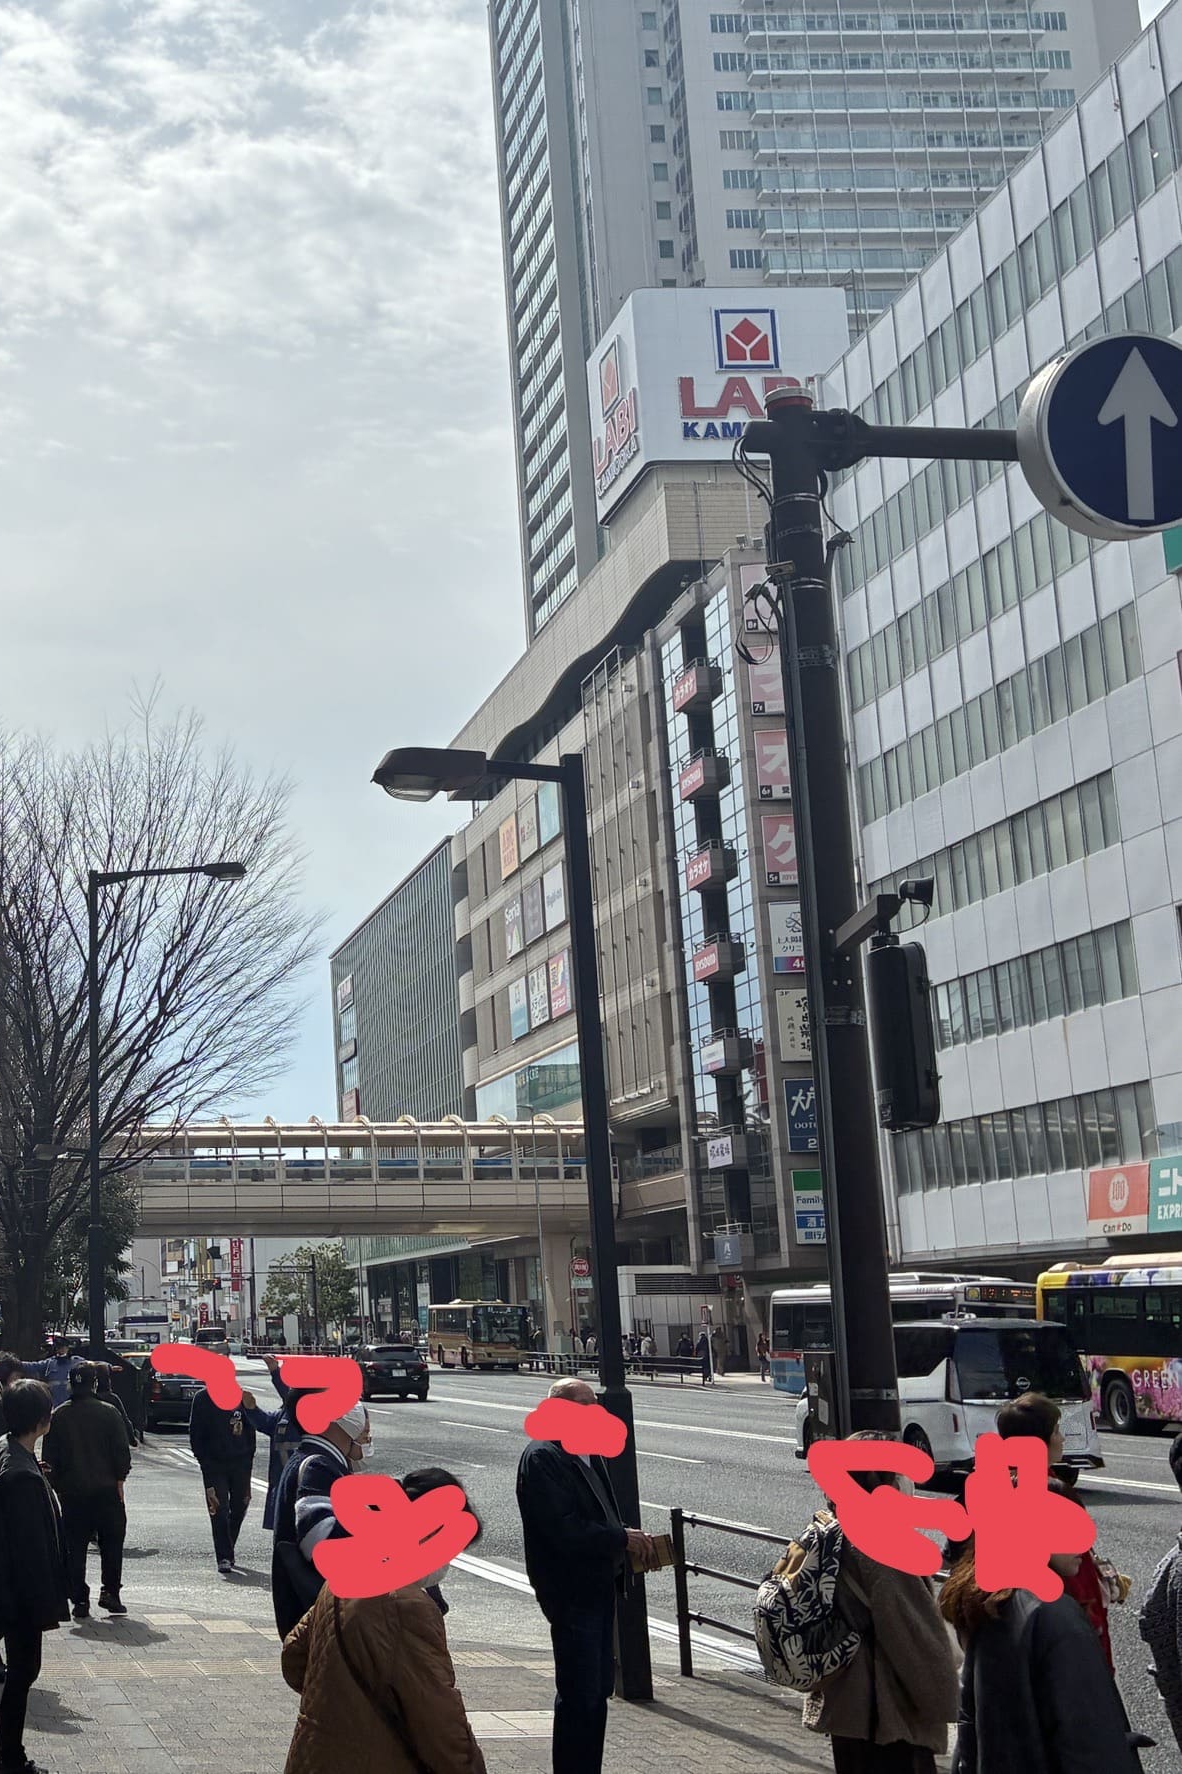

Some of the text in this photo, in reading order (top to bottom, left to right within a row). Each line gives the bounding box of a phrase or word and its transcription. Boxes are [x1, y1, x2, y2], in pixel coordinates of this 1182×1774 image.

[679, 376, 815, 418] LA
[593, 388, 637, 479] LABI
[683, 421, 746, 440] KAM
[1157, 1203, 1182, 1220] EXPR
